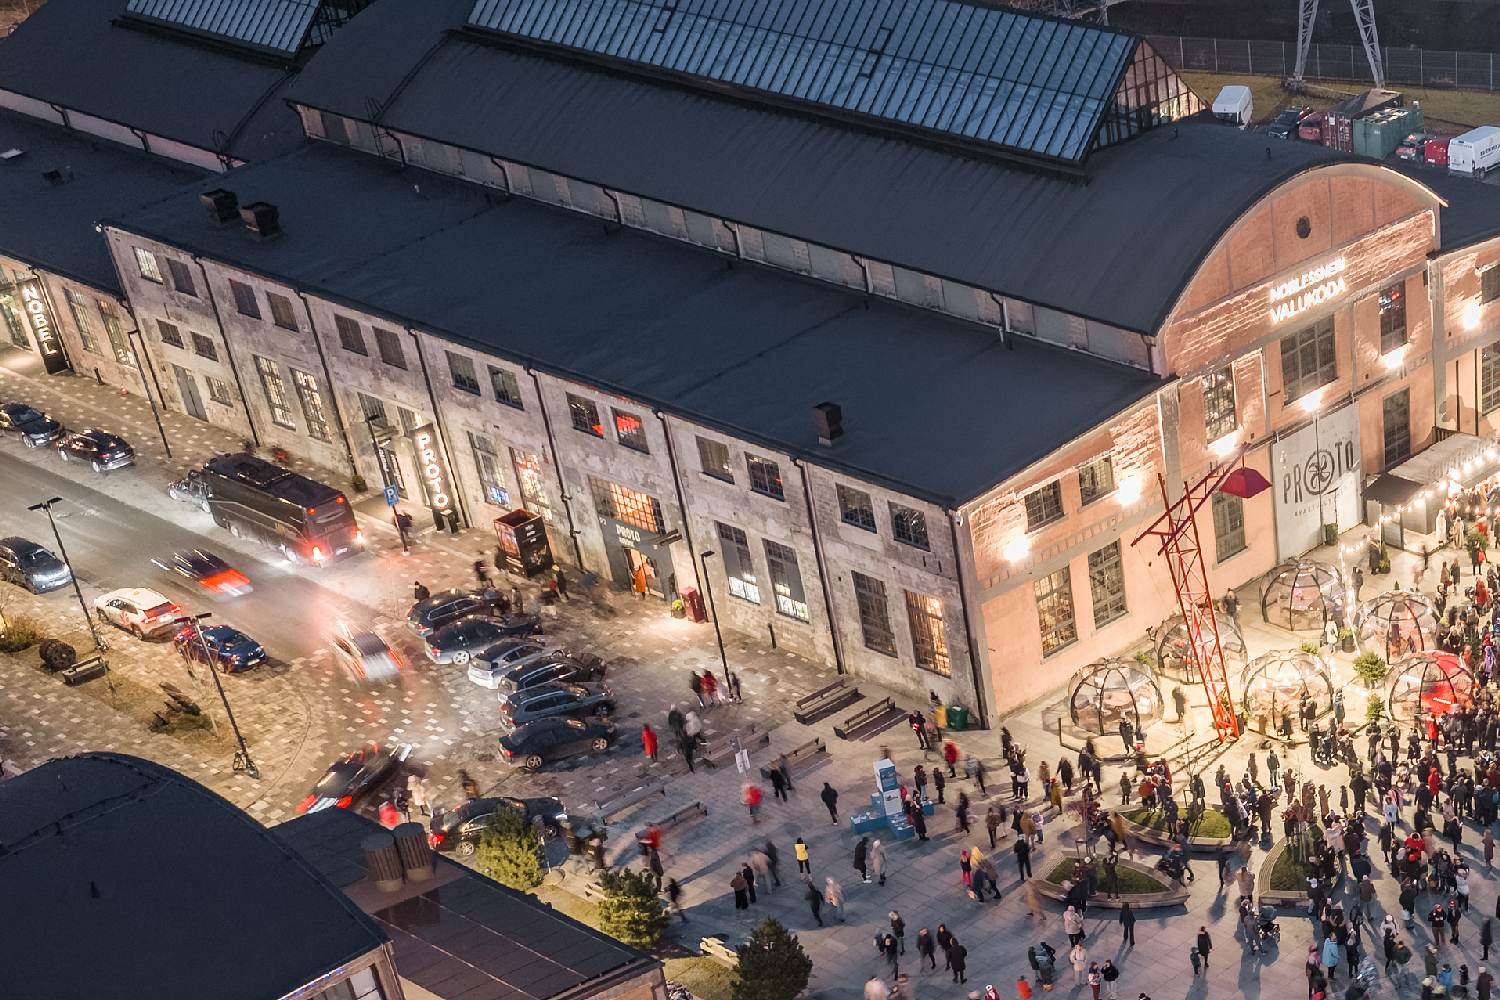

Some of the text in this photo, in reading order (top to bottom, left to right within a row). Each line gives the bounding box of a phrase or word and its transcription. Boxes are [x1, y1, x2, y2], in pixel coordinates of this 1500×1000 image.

[22, 284, 58, 354] NOBEL
[1270, 276, 1345, 325] VALUKODA
[419, 433, 449, 509] PROTO
[616, 524, 641, 542] PROTO
